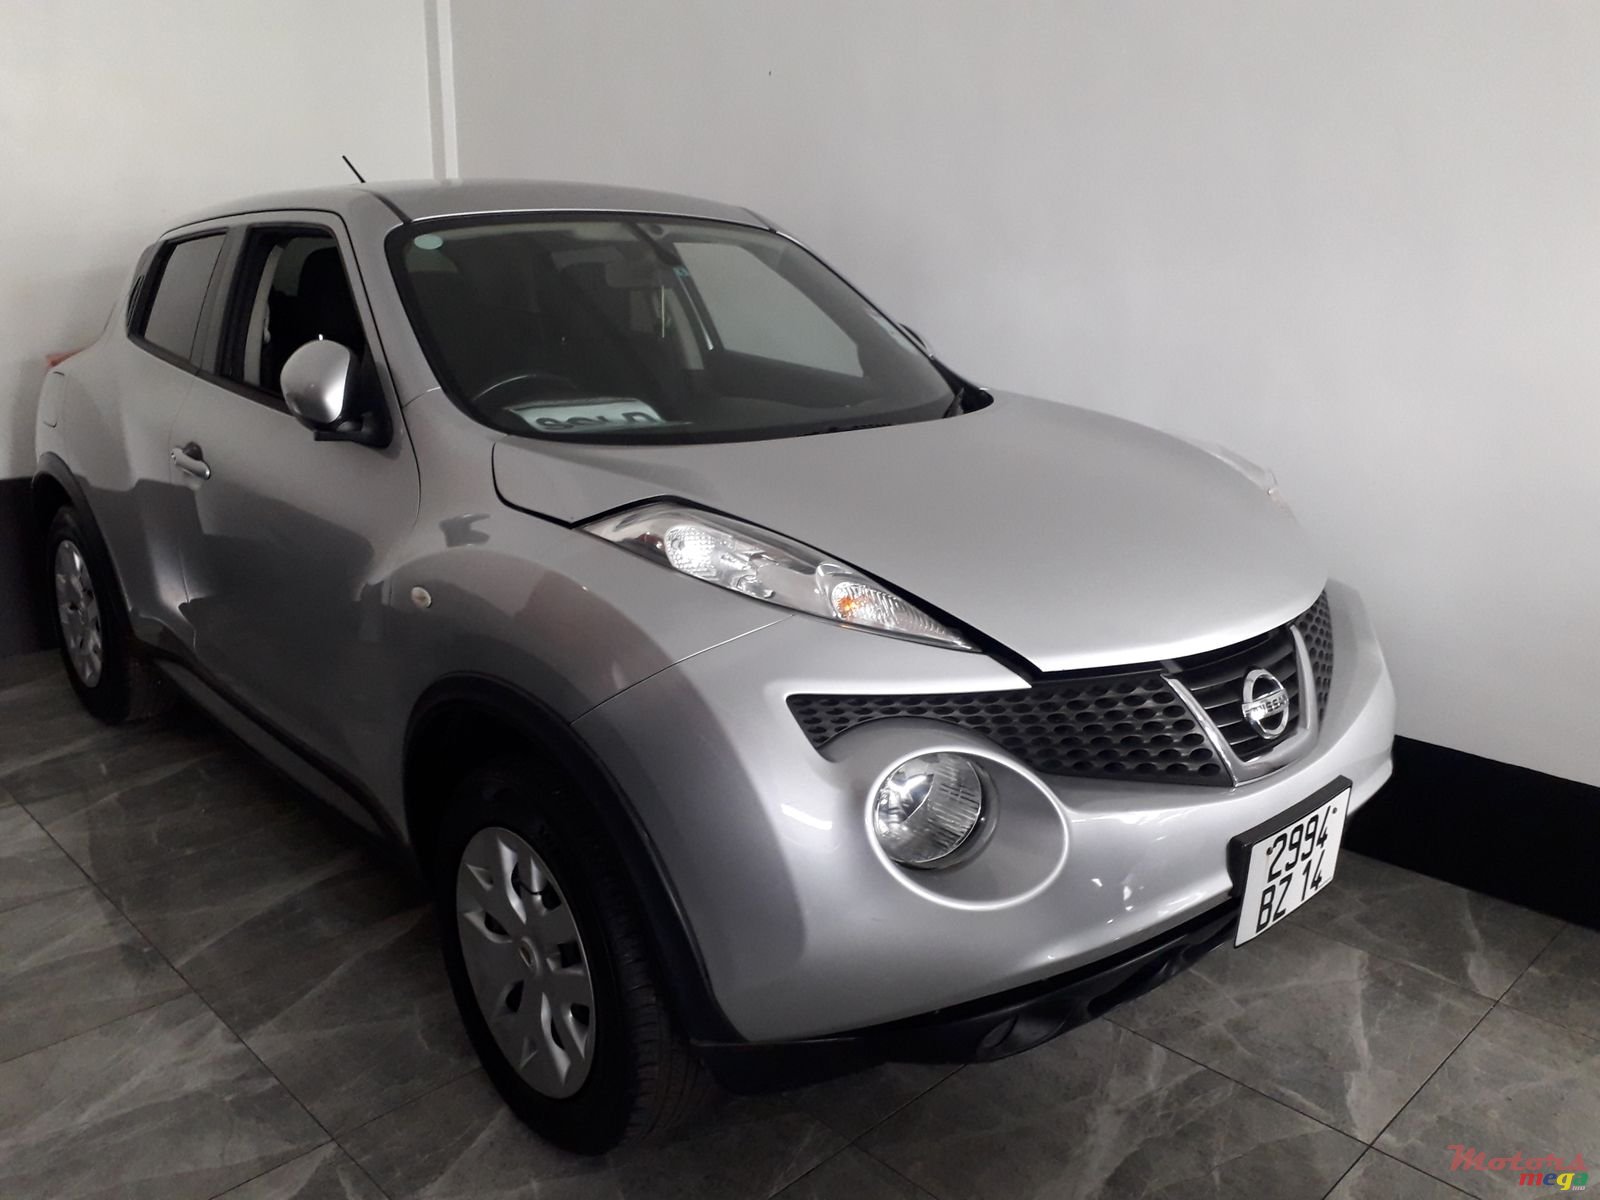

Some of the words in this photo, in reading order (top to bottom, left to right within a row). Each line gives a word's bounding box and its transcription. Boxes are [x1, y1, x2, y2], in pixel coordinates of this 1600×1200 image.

[1250, 694, 1288, 716] ISSAN
[1267, 805, 1331, 883] 2994
[1256, 872, 1293, 933] BZ
[1301, 849, 1325, 901] 14
